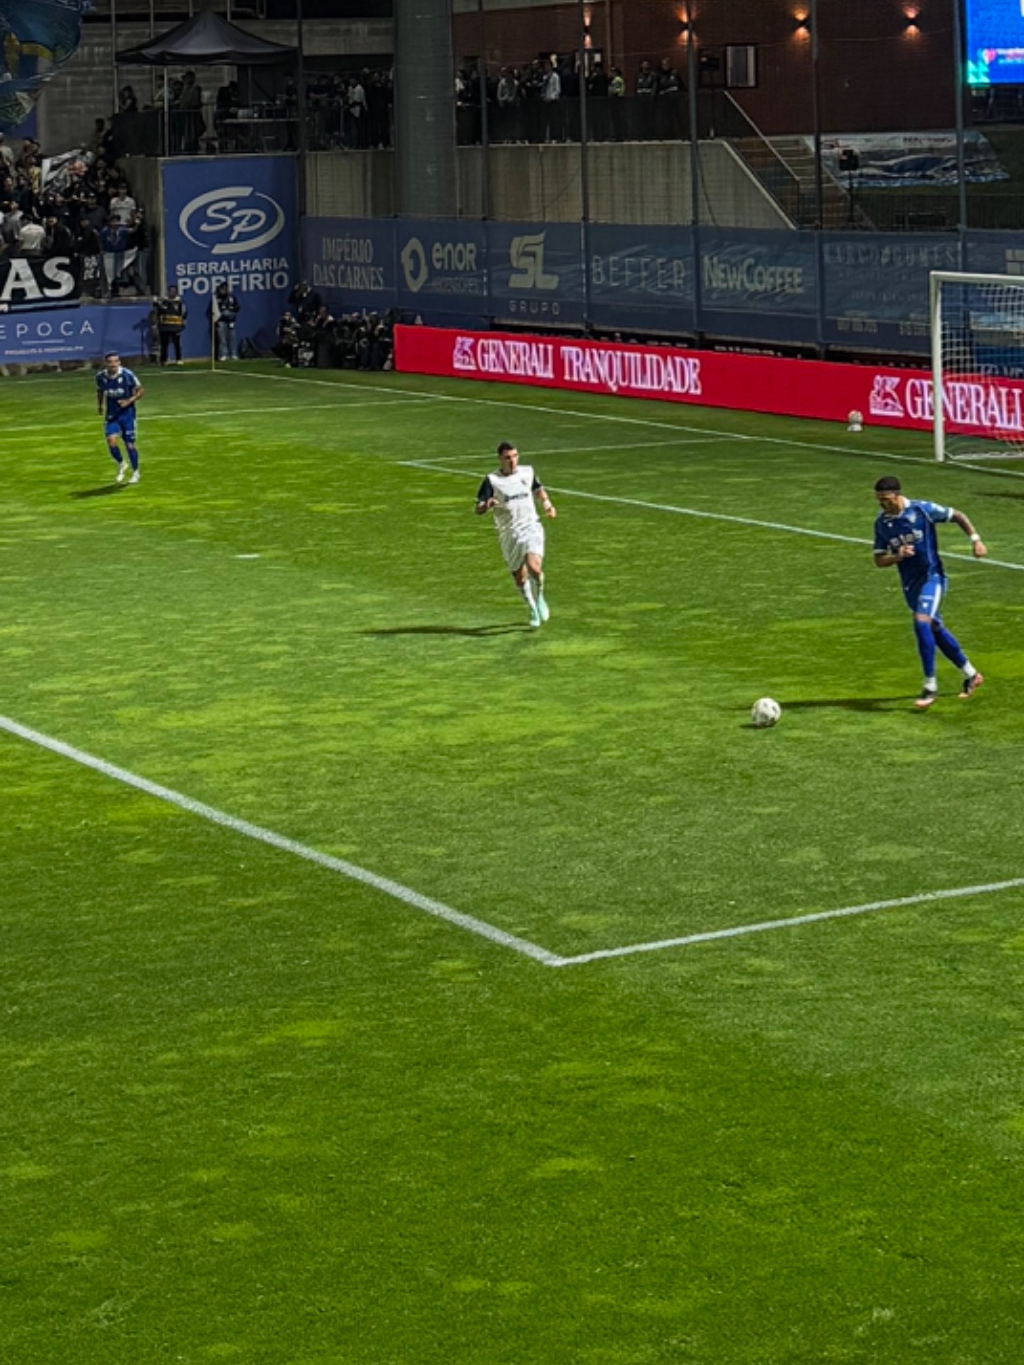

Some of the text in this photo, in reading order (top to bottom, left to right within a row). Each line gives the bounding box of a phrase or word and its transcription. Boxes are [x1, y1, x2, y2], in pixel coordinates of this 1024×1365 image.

[199, 200, 267, 241] SP
[322, 233, 374, 263] IMPÉRIO
[0, 256, 75, 301] AS
[175, 257, 289, 277] SERRALHARIA
[312, 264, 384, 290] DAS CARNES
[508, 299, 561, 316] GRUPO
[476, 341, 701, 396] GENERALI TRANQUILIDADE
